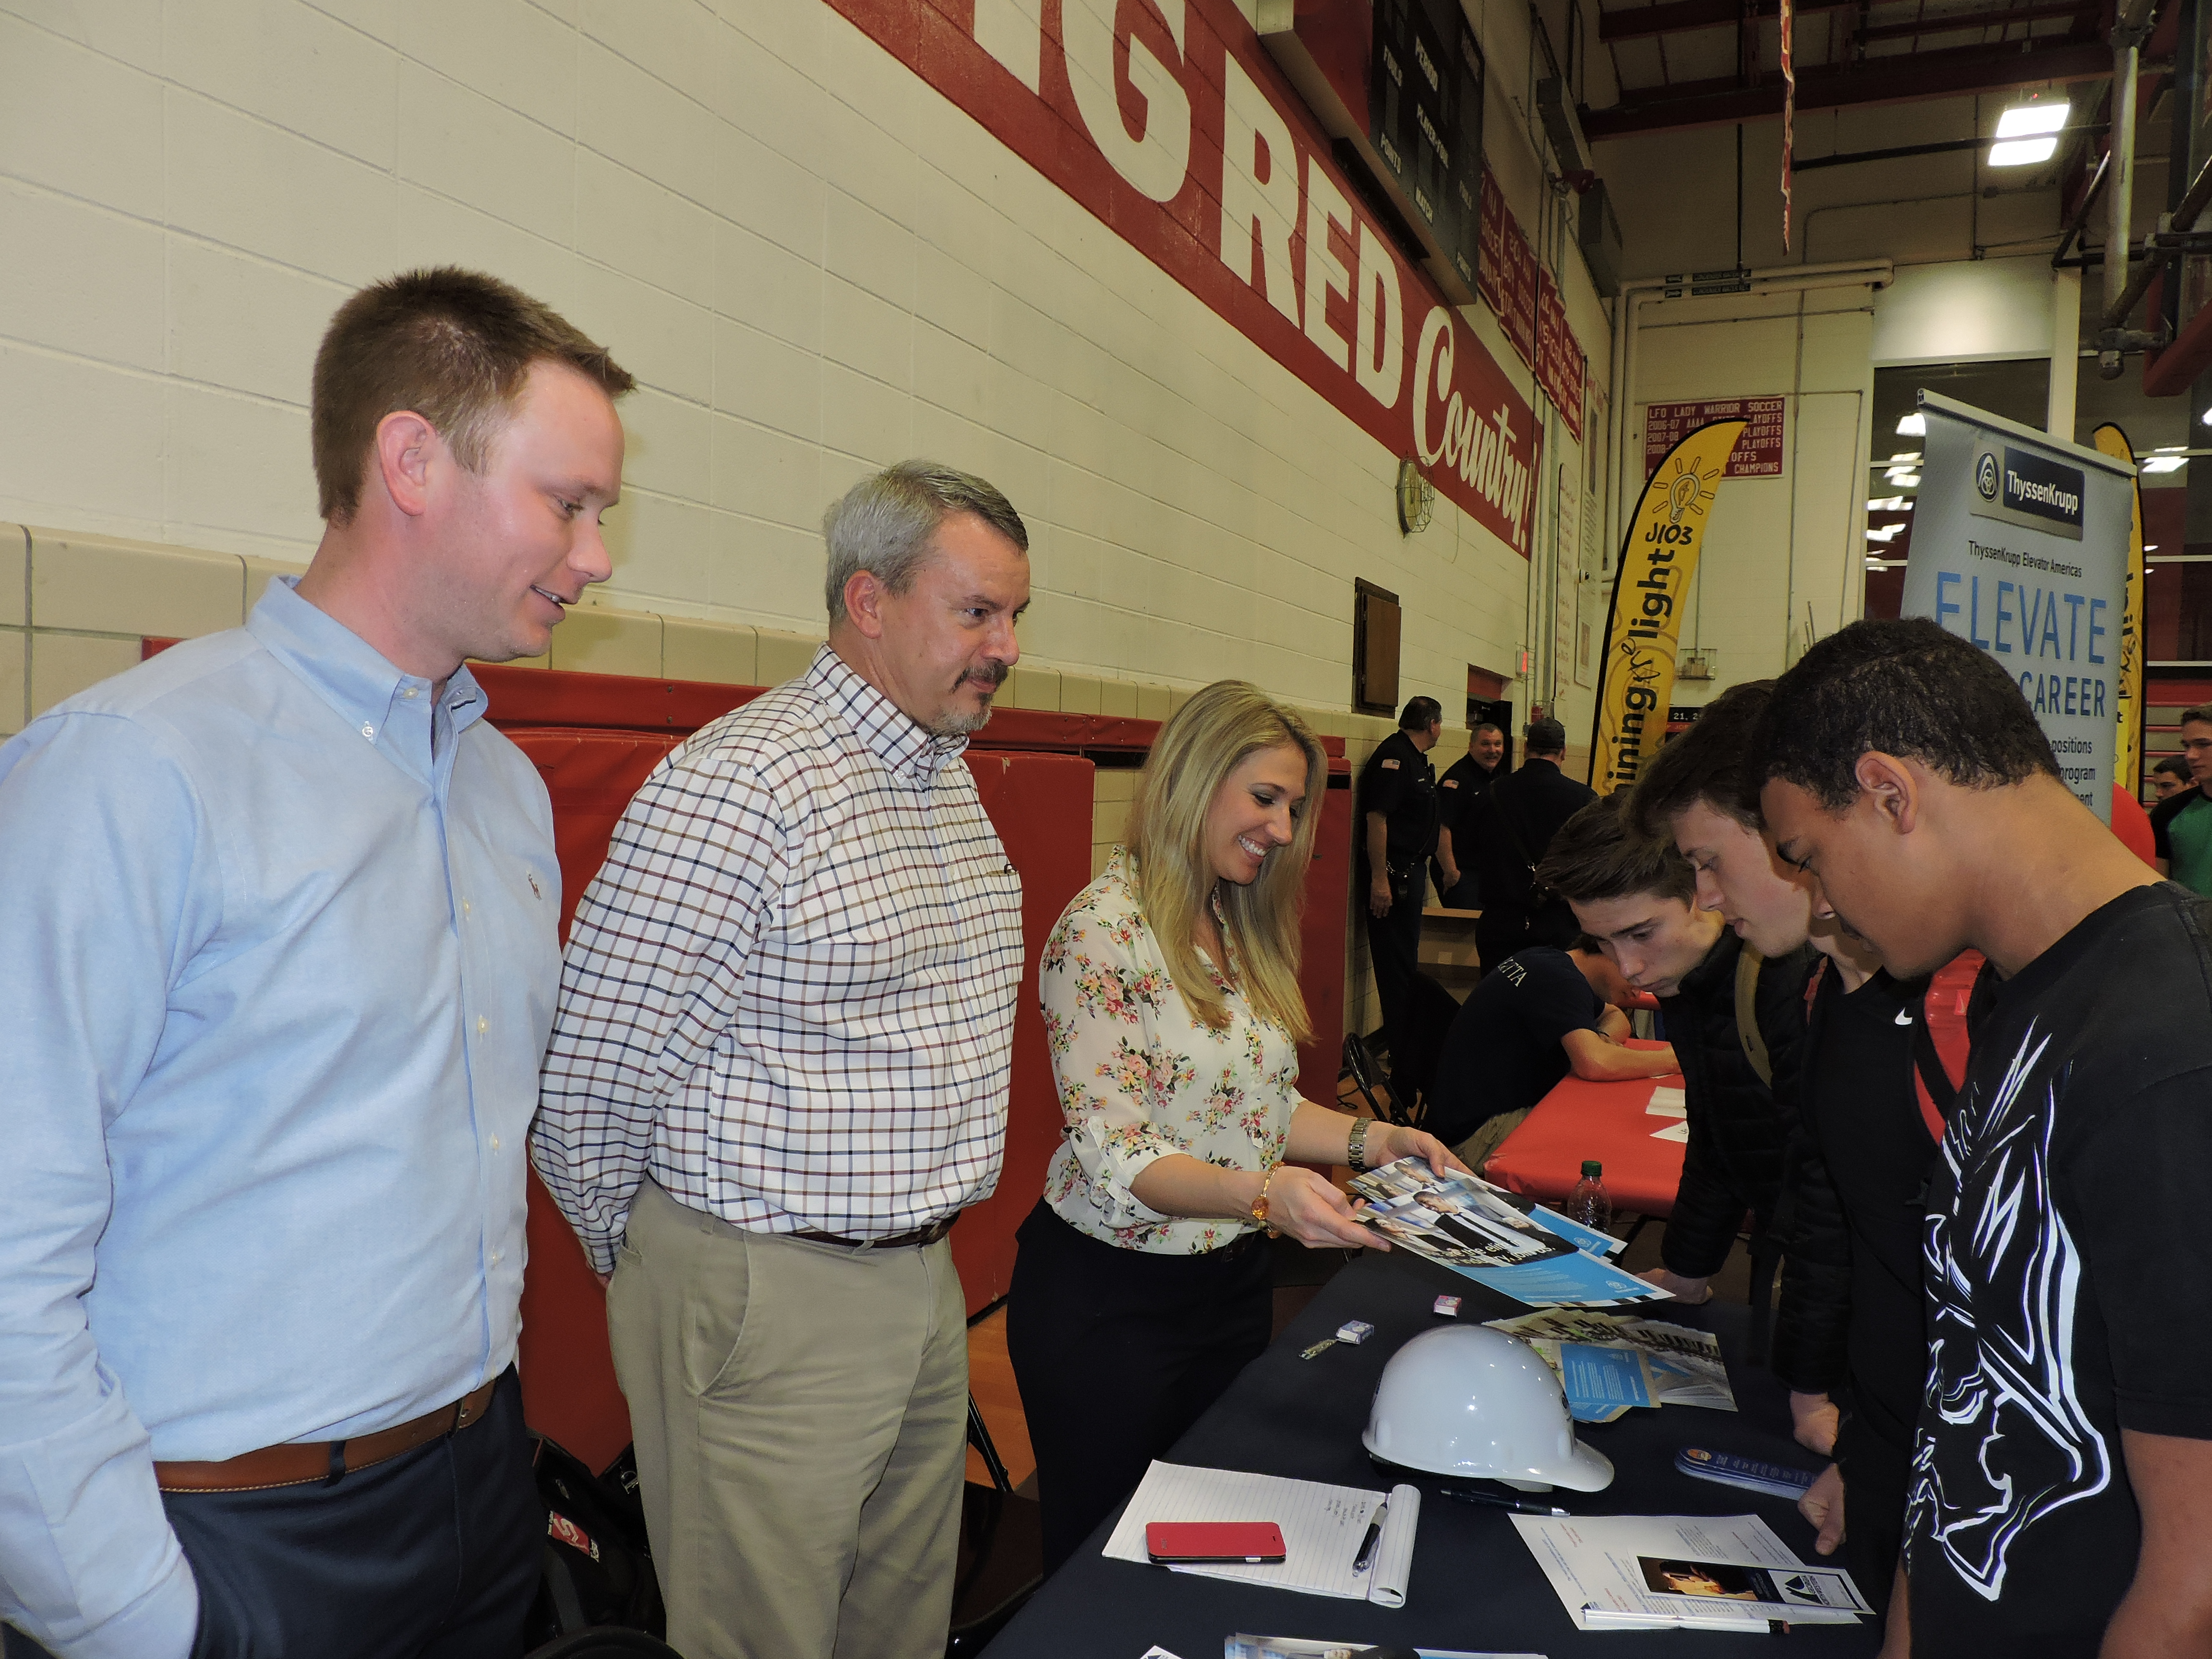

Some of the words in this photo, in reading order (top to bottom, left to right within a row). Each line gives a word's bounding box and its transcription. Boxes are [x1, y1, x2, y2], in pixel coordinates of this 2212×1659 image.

[1415, 36, 1439, 92] PERIOD
[1221, 49, 1404, 409] RED
[1413, 305, 1537, 553] Country!
[1649, 408, 1667, 419] LFO
[1674, 406, 1695, 416] LADY
[1704, 403, 1741, 414] WARRIOR
[1748, 401, 1782, 412] SOCCER
[1647, 444, 1674, 454] 2008-
[1742, 438, 1781, 449] PLAYOFFS
[1743, 426, 1781, 437] PLAYOFFS
[1734, 462, 1779, 474] CHAMPIONS
[2007, 469, 2079, 516] ThyssenKrupp
[1968, 540, 2020, 567] ThyssenKrupp
[2022, 552, 2049, 571] Elevator
[2050, 559, 2082, 577] Americas
[1627, 548, 1675, 638] light
[1935, 571, 2107, 664] ELEVATE
[2019, 671, 2106, 718] CAREER
[1608, 687, 1657, 791] ining
[2051, 736, 2092, 754] positions
[1462, 1246, 1487, 1256] the
